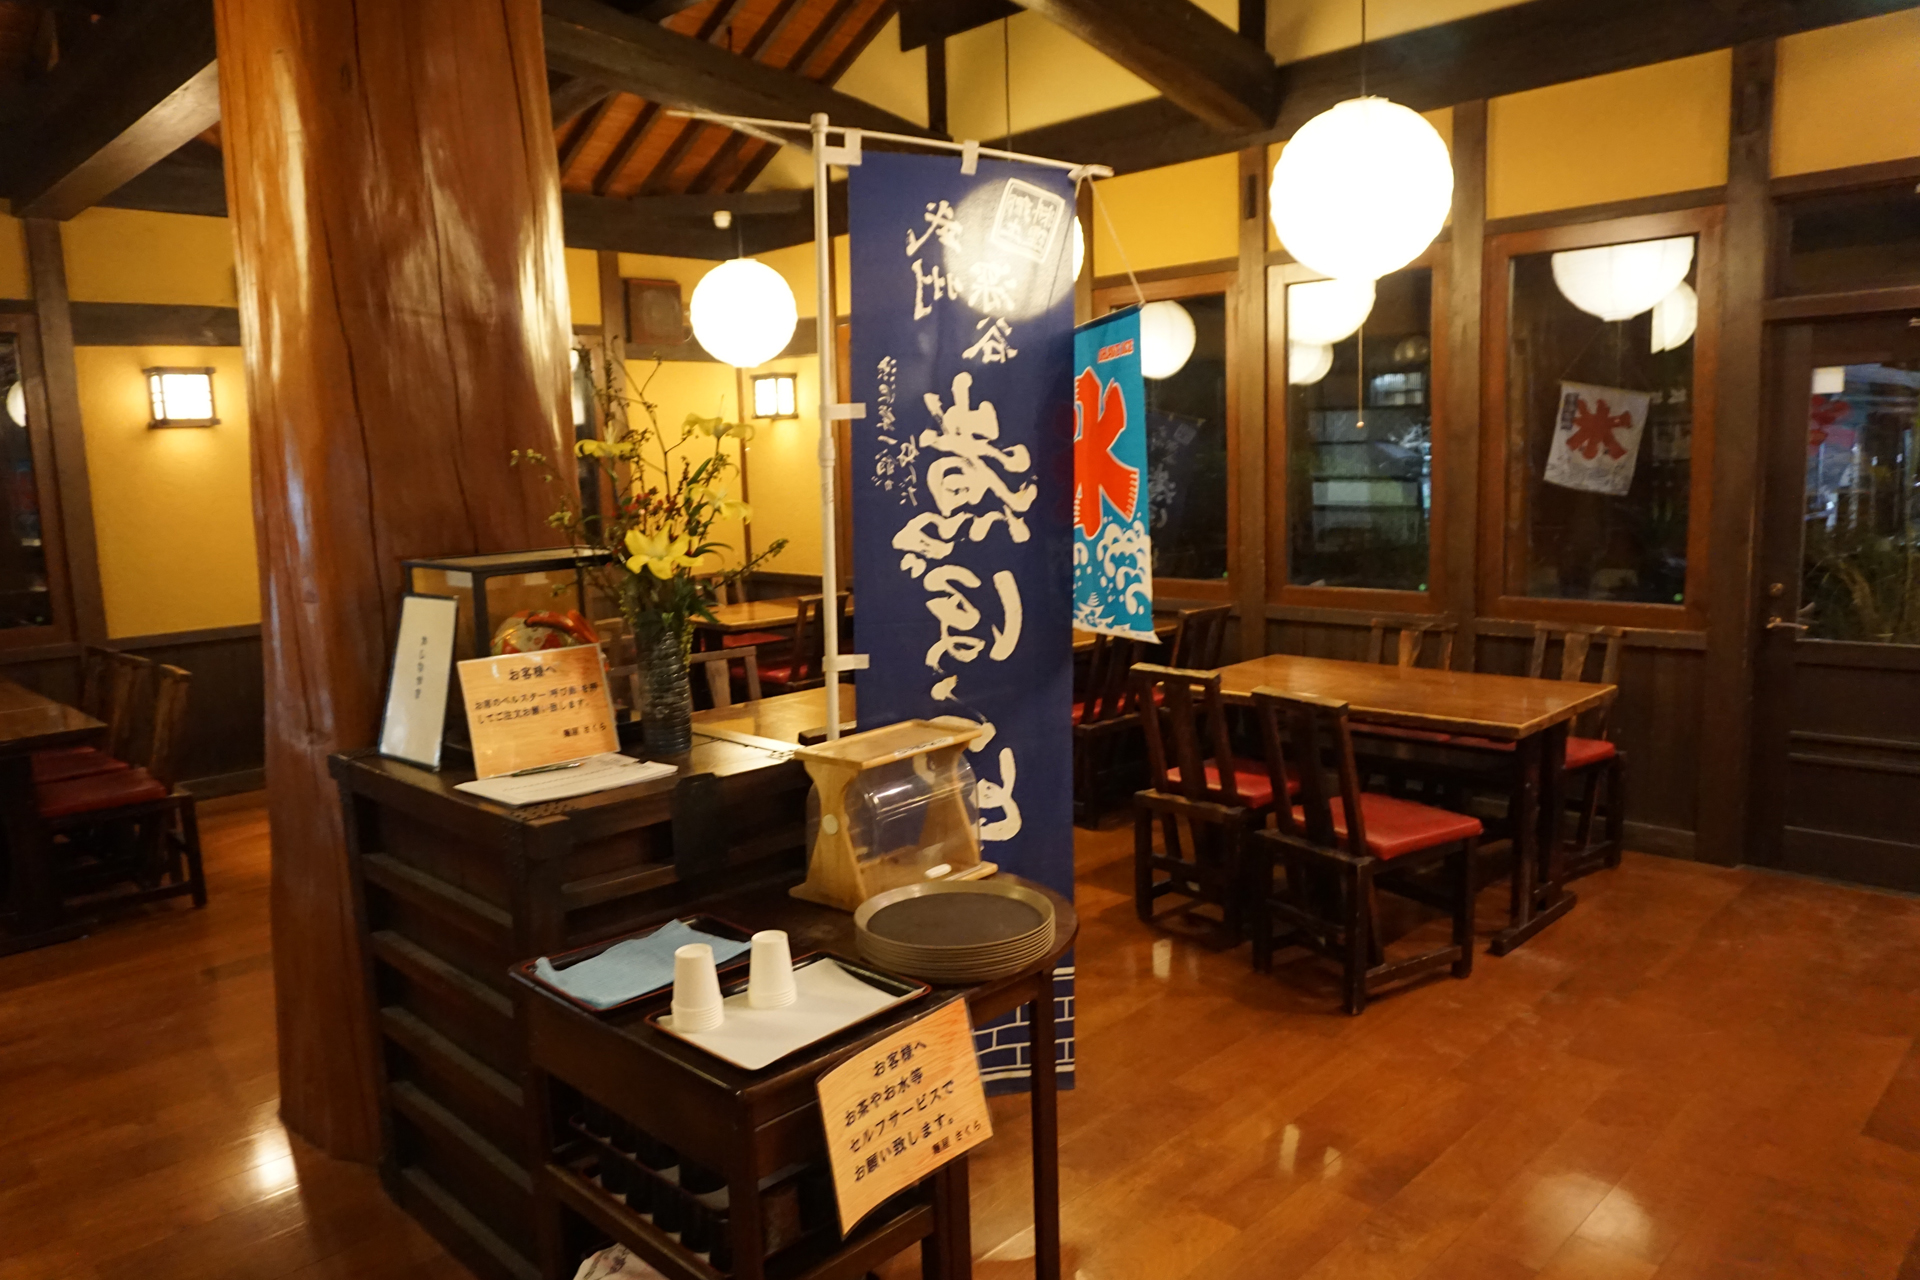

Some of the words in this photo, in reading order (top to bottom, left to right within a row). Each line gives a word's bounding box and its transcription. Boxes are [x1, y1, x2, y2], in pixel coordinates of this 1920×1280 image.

[508, 664, 558, 682] お客様へ
[872, 1039, 928, 1078] お客様へ
[844, 1065, 924, 1128] お茶やお水等
[848, 1079, 956, 1153] セルフサービスで
[853, 1112, 956, 1183] お願い致します。
[955, 1119, 983, 1143] さくら
